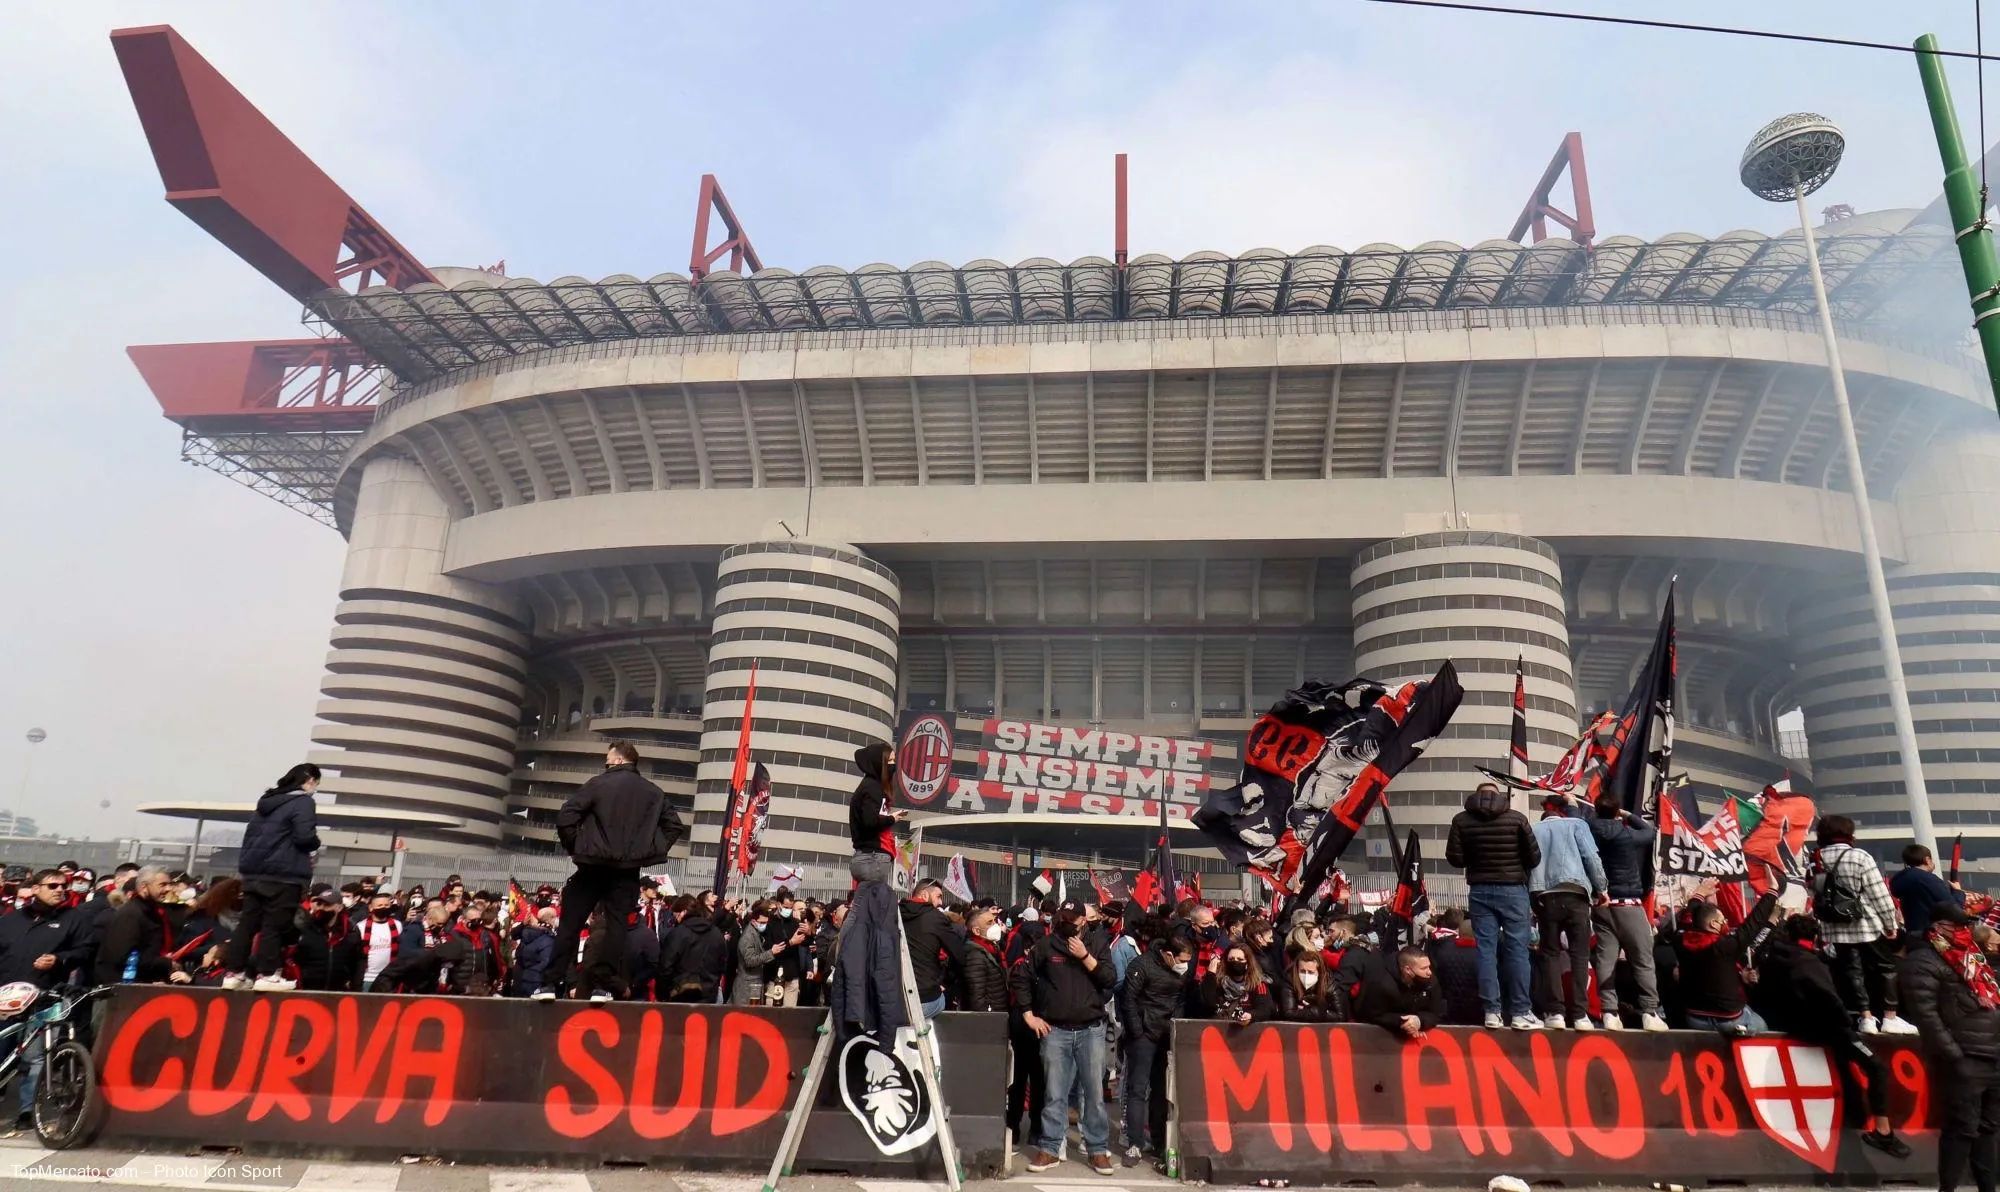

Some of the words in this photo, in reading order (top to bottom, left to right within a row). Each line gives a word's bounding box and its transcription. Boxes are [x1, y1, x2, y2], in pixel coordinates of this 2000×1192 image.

[914, 721, 943, 737] ACM
[994, 719, 1204, 772] SEMPRE
[909, 782, 934, 793] 1899
[946, 778, 986, 812] A
[1003, 784, 1068, 815] TE
[1080, 793, 1201, 820] SAR
[984, 750, 1203, 806] INSIEME
[1668, 847, 1748, 876] STANC
[103, 993, 465, 1128] CURVA
[544, 1009, 791, 1140] SUD
[1201, 1025, 1646, 1160] MILANO
[1660, 1049, 1739, 1137] 18
[1849, 1049, 1930, 1137] 9
